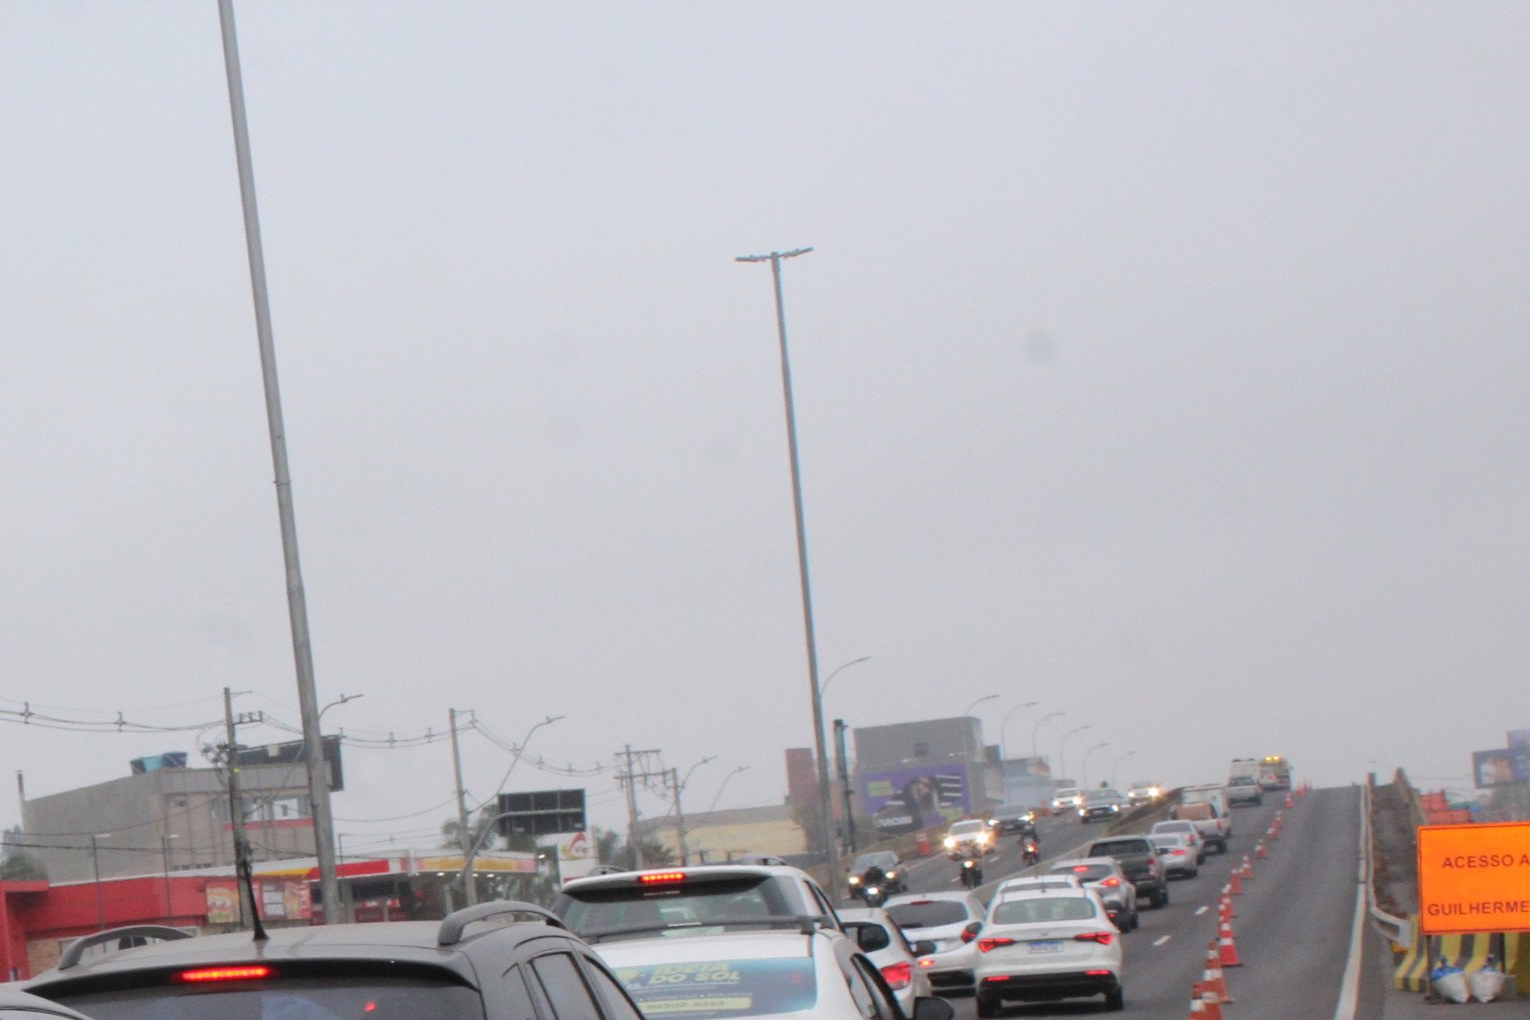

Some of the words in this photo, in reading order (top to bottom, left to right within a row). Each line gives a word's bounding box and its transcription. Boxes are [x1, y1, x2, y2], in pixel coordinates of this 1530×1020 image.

[1442, 854, 1514, 869] ACESSO
[1519, 854, 1530, 866] A
[1428, 901, 1530, 916] GUILHERME
